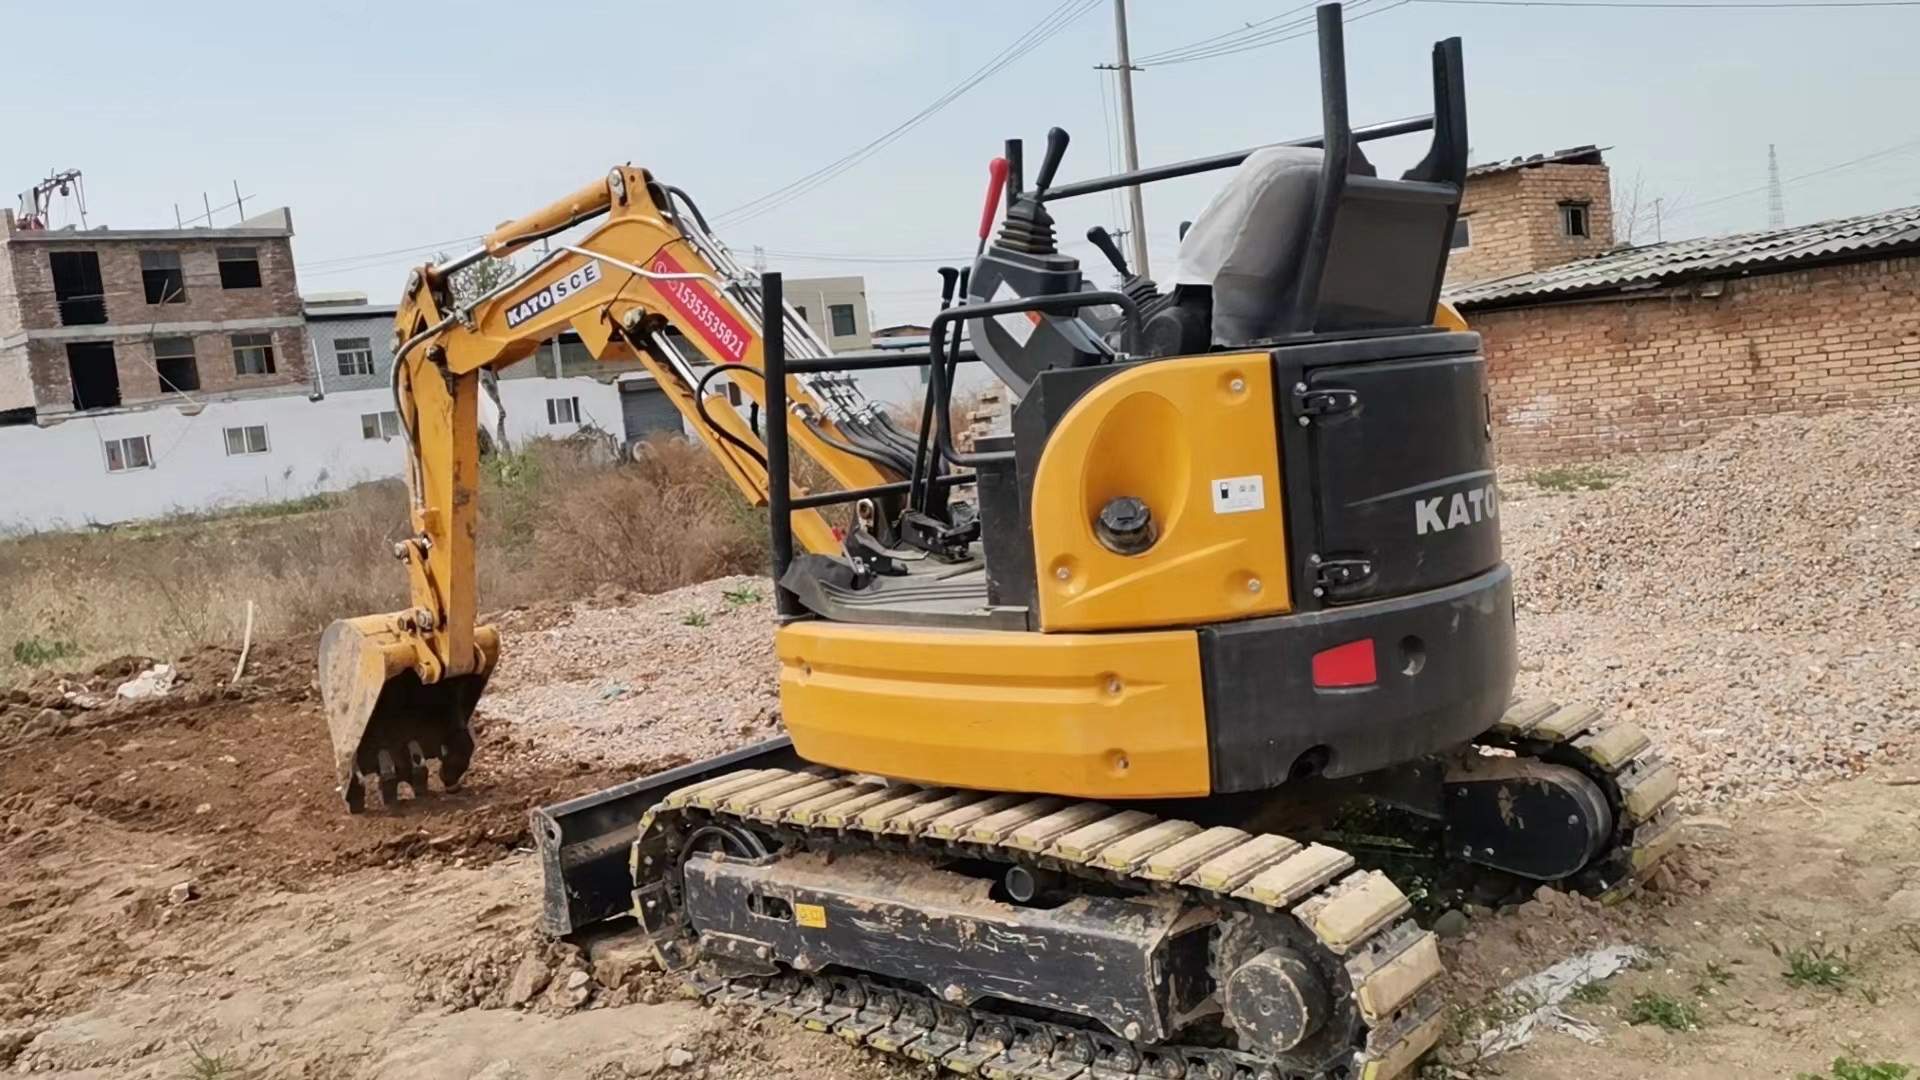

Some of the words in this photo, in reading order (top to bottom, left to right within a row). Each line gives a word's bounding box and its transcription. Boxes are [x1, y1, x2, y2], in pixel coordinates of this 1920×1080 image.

[507, 290, 552, 326] KATO
[556, 265, 596, 297] SCE
[675, 281, 745, 358] 15353535821
[1415, 483, 1496, 535] KATO
